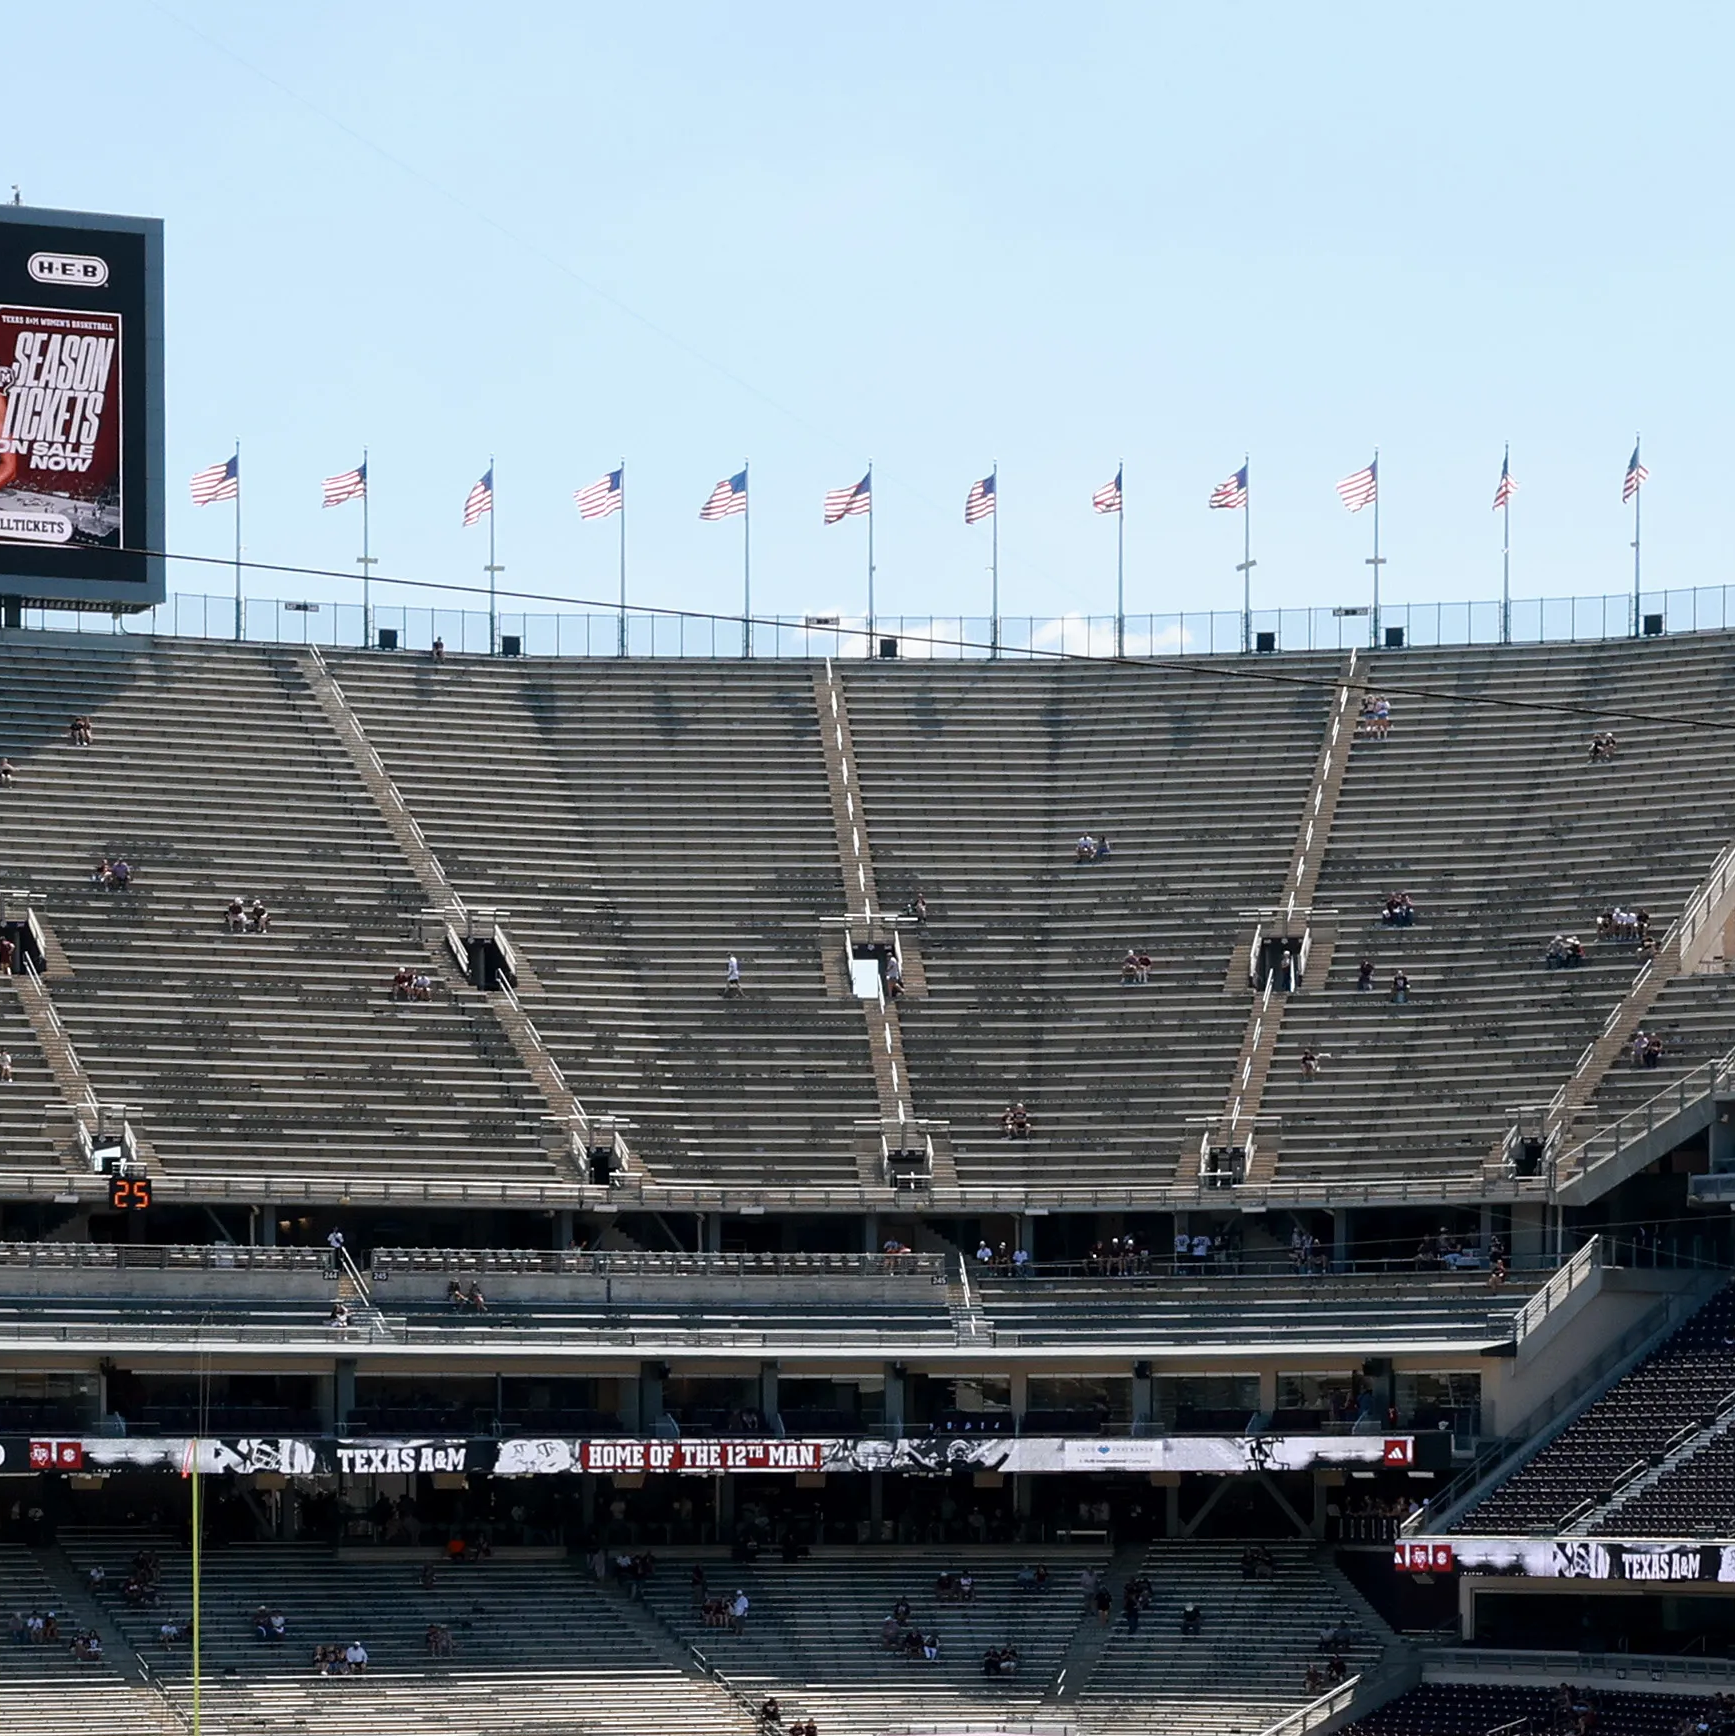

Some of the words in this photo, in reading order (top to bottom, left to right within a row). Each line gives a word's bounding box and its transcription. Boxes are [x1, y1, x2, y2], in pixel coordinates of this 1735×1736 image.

[14, 331, 115, 392] SEASON
[3, 386, 104, 444] TICKETS
[32, 441, 95, 458] SALE
[29, 455, 92, 472] NOW
[114, 1180, 149, 1208] 25
[336, 1448, 415, 1473] TEXAS
[418, 1447, 467, 1472] A&M
[588, 1445, 645, 1468] HOME
[650, 1445, 675, 1468] OF
[679, 1445, 722, 1468] THE
[726, 1445, 765, 1468] 12TH
[1622, 1552, 1669, 1580] TEXAS
[1671, 1552, 1702, 1580] A&M
